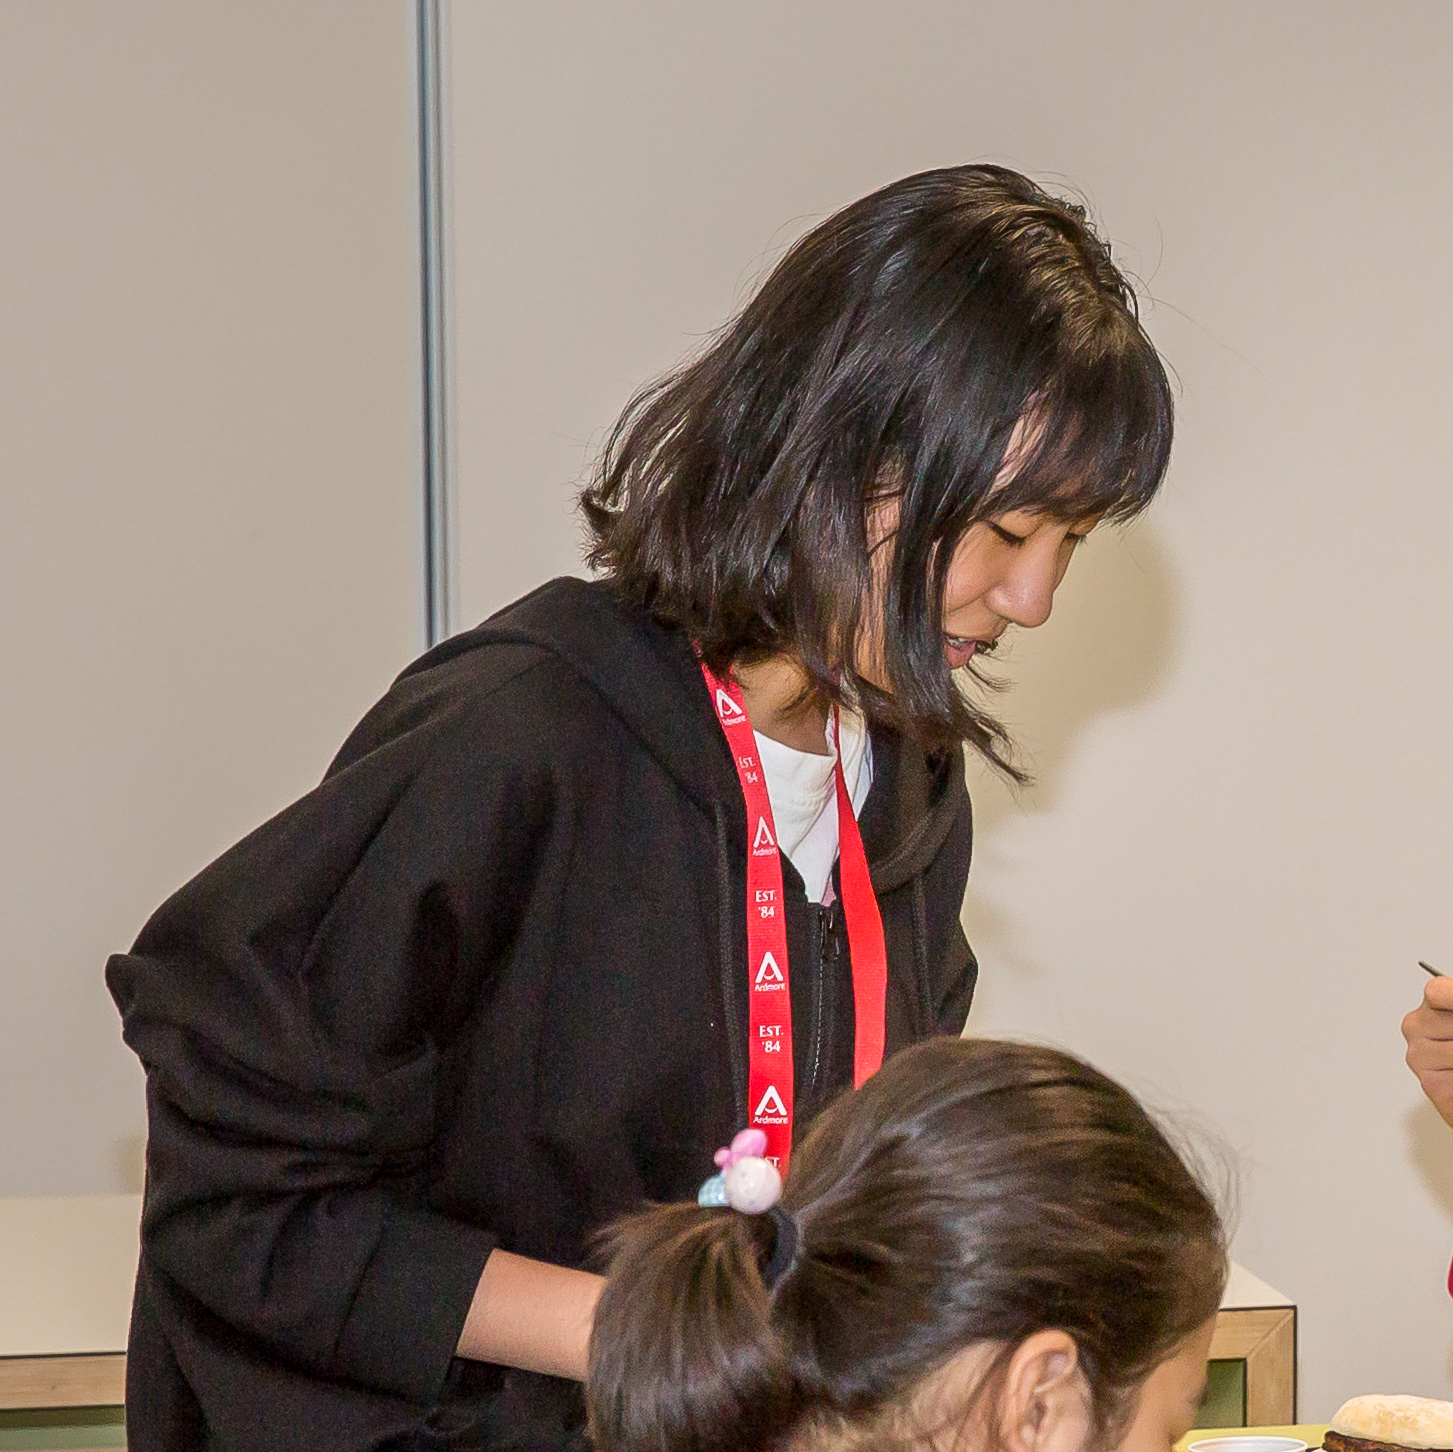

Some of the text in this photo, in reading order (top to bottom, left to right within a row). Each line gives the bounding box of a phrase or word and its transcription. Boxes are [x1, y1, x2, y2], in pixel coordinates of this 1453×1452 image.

[755, 890, 777, 903] EST.
[758, 906, 775, 919] '84
[754, 982, 786, 992] Ardmore
[759, 1025, 784, 1038] EST.
[761, 1040, 781, 1053] '84
[753, 1115, 789, 1125] Ardmore
